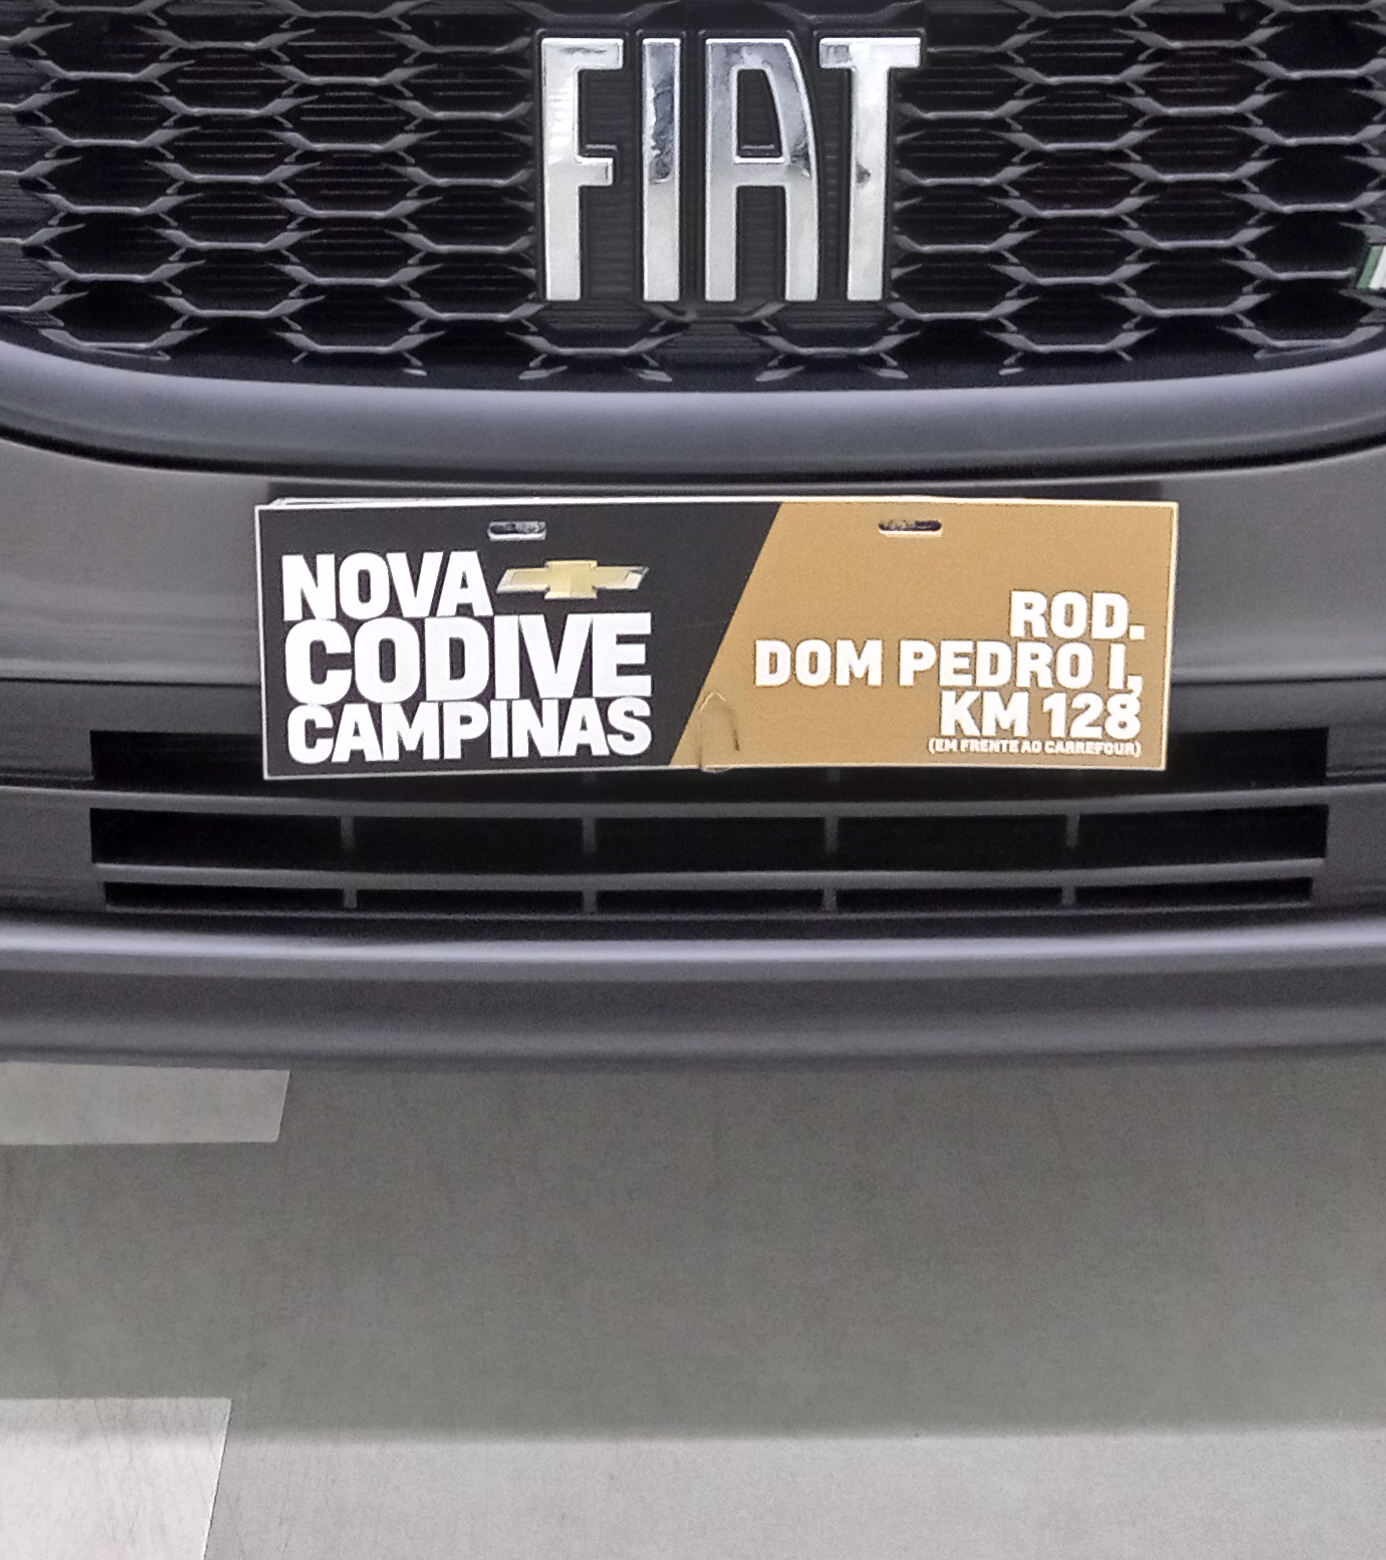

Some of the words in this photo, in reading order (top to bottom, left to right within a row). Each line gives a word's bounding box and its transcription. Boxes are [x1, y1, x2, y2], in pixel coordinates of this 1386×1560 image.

[541, 37, 921, 301] FIAT
[281, 550, 494, 621] NOVA
[1010, 590, 1145, 640] ROD.
[284, 612, 652, 705] CODIVE
[755, 639, 883, 687] DOM
[899, 639, 1093, 689] PEDRO
[1108, 643, 1143, 698] I,
[287, 696, 652, 764] CAMPINAS
[940, 690, 1029, 738] KM
[1042, 692, 1141, 740] 128
[927, 738, 958, 755] (EM
[960, 739, 1020, 753] FRENTE
[1021, 740, 1043, 754] AO
[1044, 740, 1142, 758] CARREFOUR)
